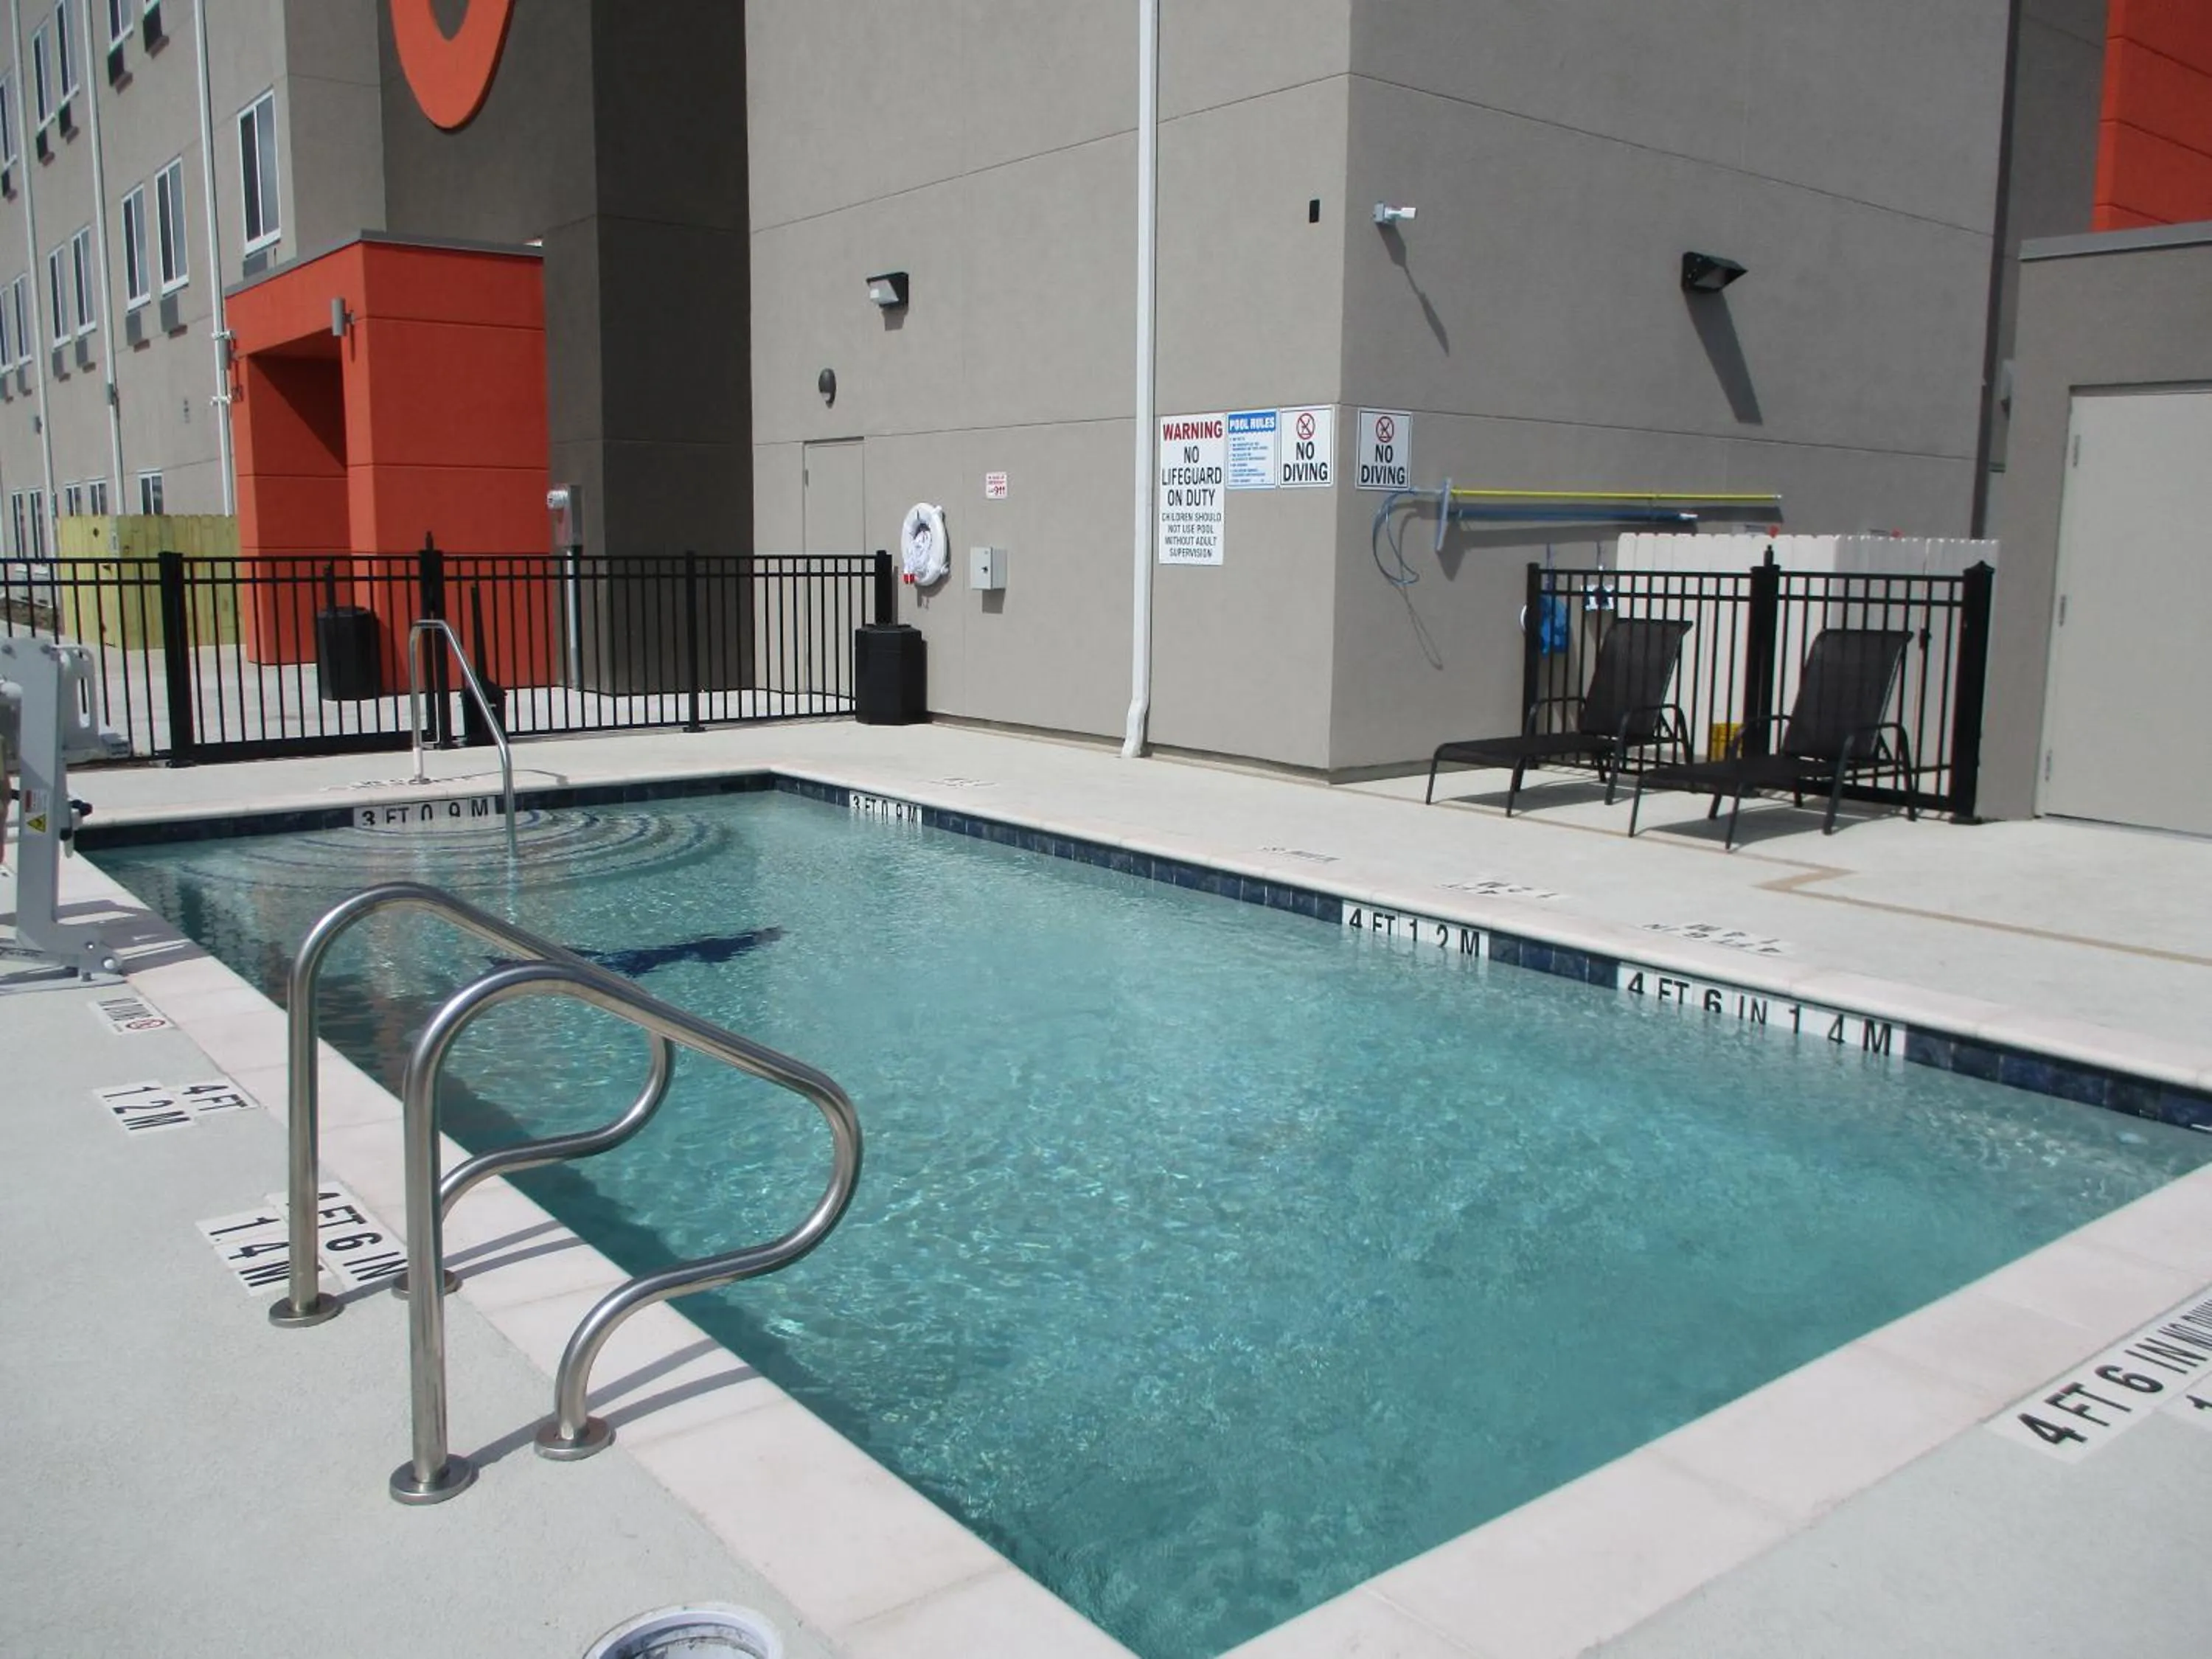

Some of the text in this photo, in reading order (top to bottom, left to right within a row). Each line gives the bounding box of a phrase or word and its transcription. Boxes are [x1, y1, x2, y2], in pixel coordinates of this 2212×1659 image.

[1163, 420, 1223, 440] WARNING
[1229, 417, 1275, 431] POOL RULES
[1183, 446, 1200, 464] NO
[1295, 442, 1315, 460] NO
[1375, 445, 1394, 464] NO
[1162, 467, 1222, 486] LIFEGUARD
[1283, 462, 1328, 481] DIVING
[1361, 465, 1405, 484] DIVING
[1167, 489, 1216, 507] ON DUTY
[1161, 512, 1222, 522] CHILDREN SHOULD
[1168, 525, 1214, 534] NOT USE POOL
[1165, 536, 1217, 546] WITHOUT ADULT
[1169, 548, 1213, 557] SUPERVISION
[362, 810, 375, 826] 3
[386, 807, 409, 824] FT
[472, 799, 488, 818] M
[853, 796, 860, 810] 3
[865, 798, 876, 813] FT
[1349, 908, 1363, 928] 4
[1373, 912, 1396, 936] FT
[1410, 919, 1418, 942] 1
[1460, 929, 1480, 957] M
[1627, 971, 1891, 1057] 4 FT 6 IN 1 4 M
[182, 1085, 248, 1111] 4 FT
[122, 1110, 190, 1130] M
[326, 1232, 383, 1251] 6
[343, 1251, 408, 1281] IN
[2017, 1337, 2208, 1444] 4 FT 6 IN
